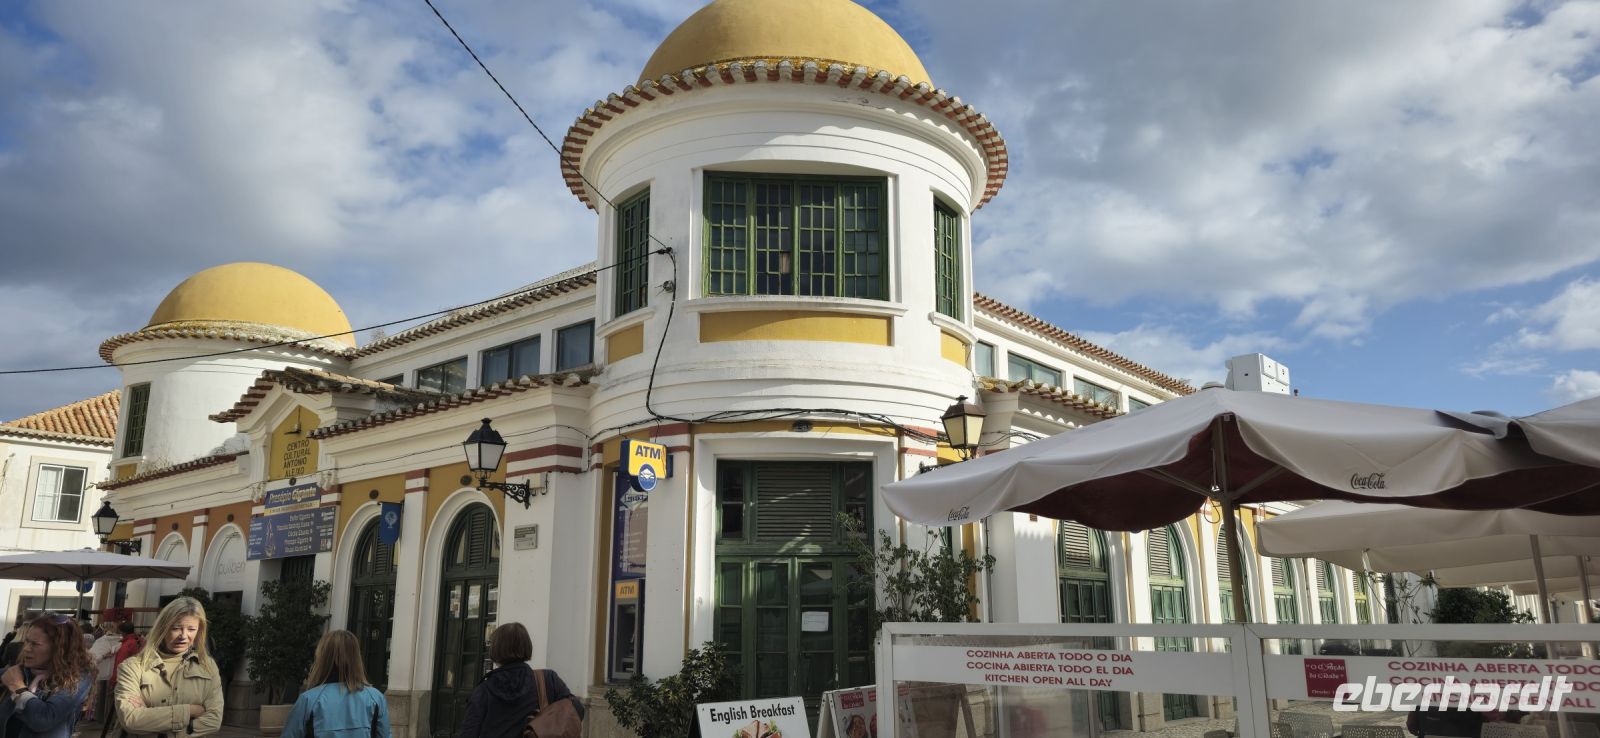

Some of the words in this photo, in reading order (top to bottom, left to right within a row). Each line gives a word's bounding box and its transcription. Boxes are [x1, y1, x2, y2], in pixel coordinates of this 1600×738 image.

[287, 439, 310, 451] CENTRO
[283, 447, 312, 460] CULTURAL
[635, 445, 661, 460] ATM
[285, 467, 305, 477] ALEIXO
[292, 486, 317, 502] Gigante
[619, 584, 635, 596] ATM
[966, 649, 1014, 659] COZINHA
[1017, 651, 1056, 660] ABERTA
[1058, 652, 1093, 661] TODO
[1097, 653, 1108, 662] O
[1111, 653, 1133, 663] DIA
[966, 661, 1010, 671] COCINA
[1013, 663, 1055, 672] ABIERTA
[1058, 664, 1093, 674] TODO
[1096, 665, 1108, 674] EL
[1112, 666, 1134, 675] DIA
[1388, 661, 1468, 673] COZINHA
[1474, 663, 1540, 674] ABERTA
[985, 673, 1029, 683] KITCHEN
[1032, 675, 1063, 685] OPEN
[1066, 677, 1086, 686] ALL
[1089, 678, 1113, 687] DAY
[1562, 697, 1597, 708] ALL
[710, 705, 748, 725] English
[749, 703, 795, 719] Breakfast
